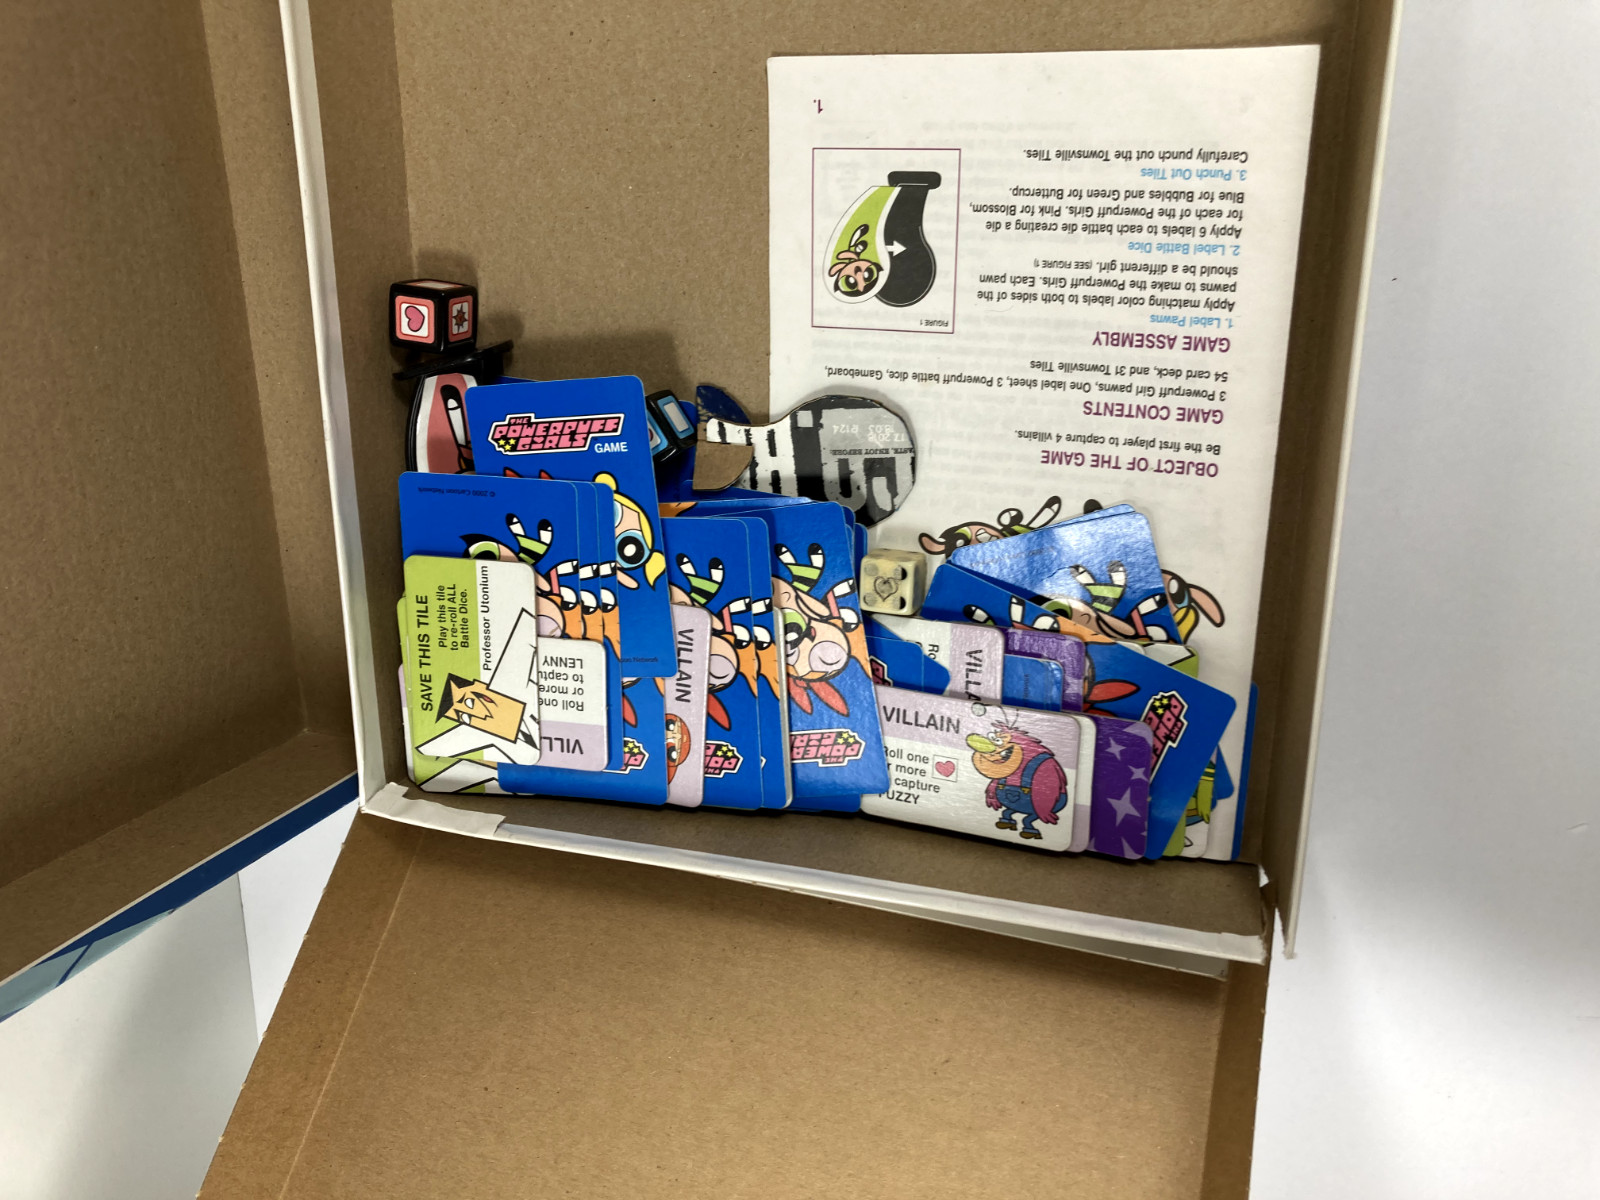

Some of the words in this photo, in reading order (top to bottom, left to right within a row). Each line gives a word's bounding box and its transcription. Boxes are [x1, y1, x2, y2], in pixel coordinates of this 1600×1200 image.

[813, 99, 824, 114] 1.
[1023, 150, 1052, 161] Tiles.
[1055, 150, 1110, 162] Townsville
[1114, 150, 1132, 162] the
[1136, 150, 1154, 161] out
[1158, 148, 1193, 162] punch
[1196, 148, 1248, 164] Carefully
[1141, 168, 1166, 180] Tiles
[1172, 169, 1192, 180] Out
[1197, 169, 1232, 180] Punch
[1237, 170, 1246, 180] 3.
[1009, 185, 1064, 200] Buttercup.
[1067, 189, 1083, 200] for
[1086, 189, 1120, 201] Green
[1124, 190, 1145, 201] and
[1149, 190, 1194, 202] Bubbles
[1198, 191, 1214, 203] for
[1218, 192, 1244, 204] Blue
[970, 202, 1016, 216] Blossom,
[1020, 205, 1035, 216] for
[1038, 206, 1061, 217] Pink
[1066, 206, 1094, 218] Girls.
[1097, 204, 1154, 219] Powerpuff
[1158, 208, 1176, 220] the
[1179, 208, 1191, 220] of
[1195, 209, 1223, 220] each
[1226, 210, 1243, 221] for
[986, 221, 1002, 232] die
[1005, 222, 1012, 230] a
[1015, 219, 1058, 233] creating
[1061, 223, 1078, 234] die
[1081, 224, 1113, 235] battle
[1117, 224, 1143, 236] each
[1147, 225, 1158, 236] to
[1162, 226, 1196, 238] labels
[1199, 226, 1206, 238] 6
[1210, 224, 1242, 239] Apply
[1128, 242, 1152, 253] Dice
[1156, 243, 1190, 254] Battle
[1194, 244, 1225, 255] Label
[1231, 245, 1240, 256] 2.
[1033, 258, 1041, 268] 1)
[1042, 259, 1072, 268] FIGURE
[1074, 260, 1092, 269] (SEE
[1096, 260, 1117, 273] girl.
[1120, 263, 1168, 275] different
[1172, 265, 1178, 273] a
[1182, 265, 1196, 276] be
[1200, 266, 1238, 278] should
[979, 273, 1006, 283] pawn
[1010, 276, 1036, 287] Each
[1040, 277, 1067, 288] Girls.
[1070, 276, 1126, 290] Powerpuff
[1129, 280, 1147, 291] the
[1150, 281, 1181, 292] make
[1185, 282, 1196, 293] to
[1200, 281, 1237, 292] pawns
[977, 291, 994, 302] the
[996, 292, 1007, 302] of
[1010, 292, 1038, 303] sides
[1041, 293, 1065, 305] both
[1068, 294, 1078, 304] to
[1082, 295, 1114, 307] labels
[1117, 296, 1145, 308] color
[1148, 295, 1200, 309] matching
[1203, 298, 1236, 312] Apply
[924, 319, 949, 327] FIGURE
[1150, 315, 1186, 326] Pawns
[1190, 317, 1220, 328] Label
[1226, 319, 1232, 328] 1.
[1092, 331, 1178, 350] ASSEMBLY
[1182, 336, 1230, 353] GAME
[1030, 360, 1054, 372] Tiles
[1058, 362, 1111, 376] Townsville
[1115, 366, 1126, 376] 31
[1129, 366, 1150, 376] and
[825, 366, 883, 380] Gameboard,
[886, 369, 908, 382] dice,
[912, 372, 940, 384] battle
[1154, 366, 1182, 379] deck,
[1186, 370, 1210, 380] card
[1214, 372, 1228, 382] 54
[942, 372, 993, 387] Powerpuff
[997, 377, 1003, 387] 3
[1006, 376, 1038, 389] sheet,
[1041, 380, 1066, 391] label
[1070, 382, 1091, 393] One
[1095, 382, 1132, 393] pawns,
[1136, 386, 1156, 397] Girl
[1158, 386, 1215, 401] Powerpuff
[1219, 391, 1226, 402] 3
[1083, 401, 1170, 420] CONTENTS
[1176, 407, 1224, 424] GAME
[510, 417, 530, 425] THE
[493, 418, 621, 439] POWERPUFF
[516, 433, 588, 450] GIRLS
[1015, 430, 1052, 442] villains.
[1056, 433, 1062, 443] 4
[1065, 433, 1105, 444] capture
[1108, 437, 1119, 447] to
[594, 442, 628, 454] GAME
[1122, 436, 1156, 450] player
[1159, 440, 1181, 452] first
[1184, 443, 1202, 454] the
[1206, 444, 1221, 455] Be
[1040, 450, 1085, 466] GAME
[1090, 454, 1122, 469] THE
[1126, 457, 1149, 473] OF
[1152, 459, 1218, 478] OBJECT
[435, 585, 446, 600] tile
[447, 583, 457, 604] ALL
[479, 565, 491, 614] Utonium
[459, 588, 469, 616] Dice.
[416, 594, 430, 628] TILE
[436, 604, 447, 624] this
[447, 606, 459, 638] re-roll
[437, 626, 449, 648] Play
[460, 623, 470, 648] Battle
[449, 641, 459, 651] to
[482, 617, 493, 671] Professor
[417, 633, 431, 668] THIS
[542, 655, 583, 669] LENNY
[675, 628, 694, 704] VILLAIN
[572, 673, 584, 684] to
[420, 673, 433, 712] SAVE
[538, 684, 569, 694] more
[571, 687, 584, 696] or
[538, 697, 559, 707] one
[562, 699, 584, 712] Roll
[882, 705, 960, 734] VILLAIN
[541, 736, 584, 755] VILL
[907, 753, 930, 764] one
[895, 764, 927, 777] more
[894, 777, 941, 793] capture
[879, 789, 920, 805] UZZY
